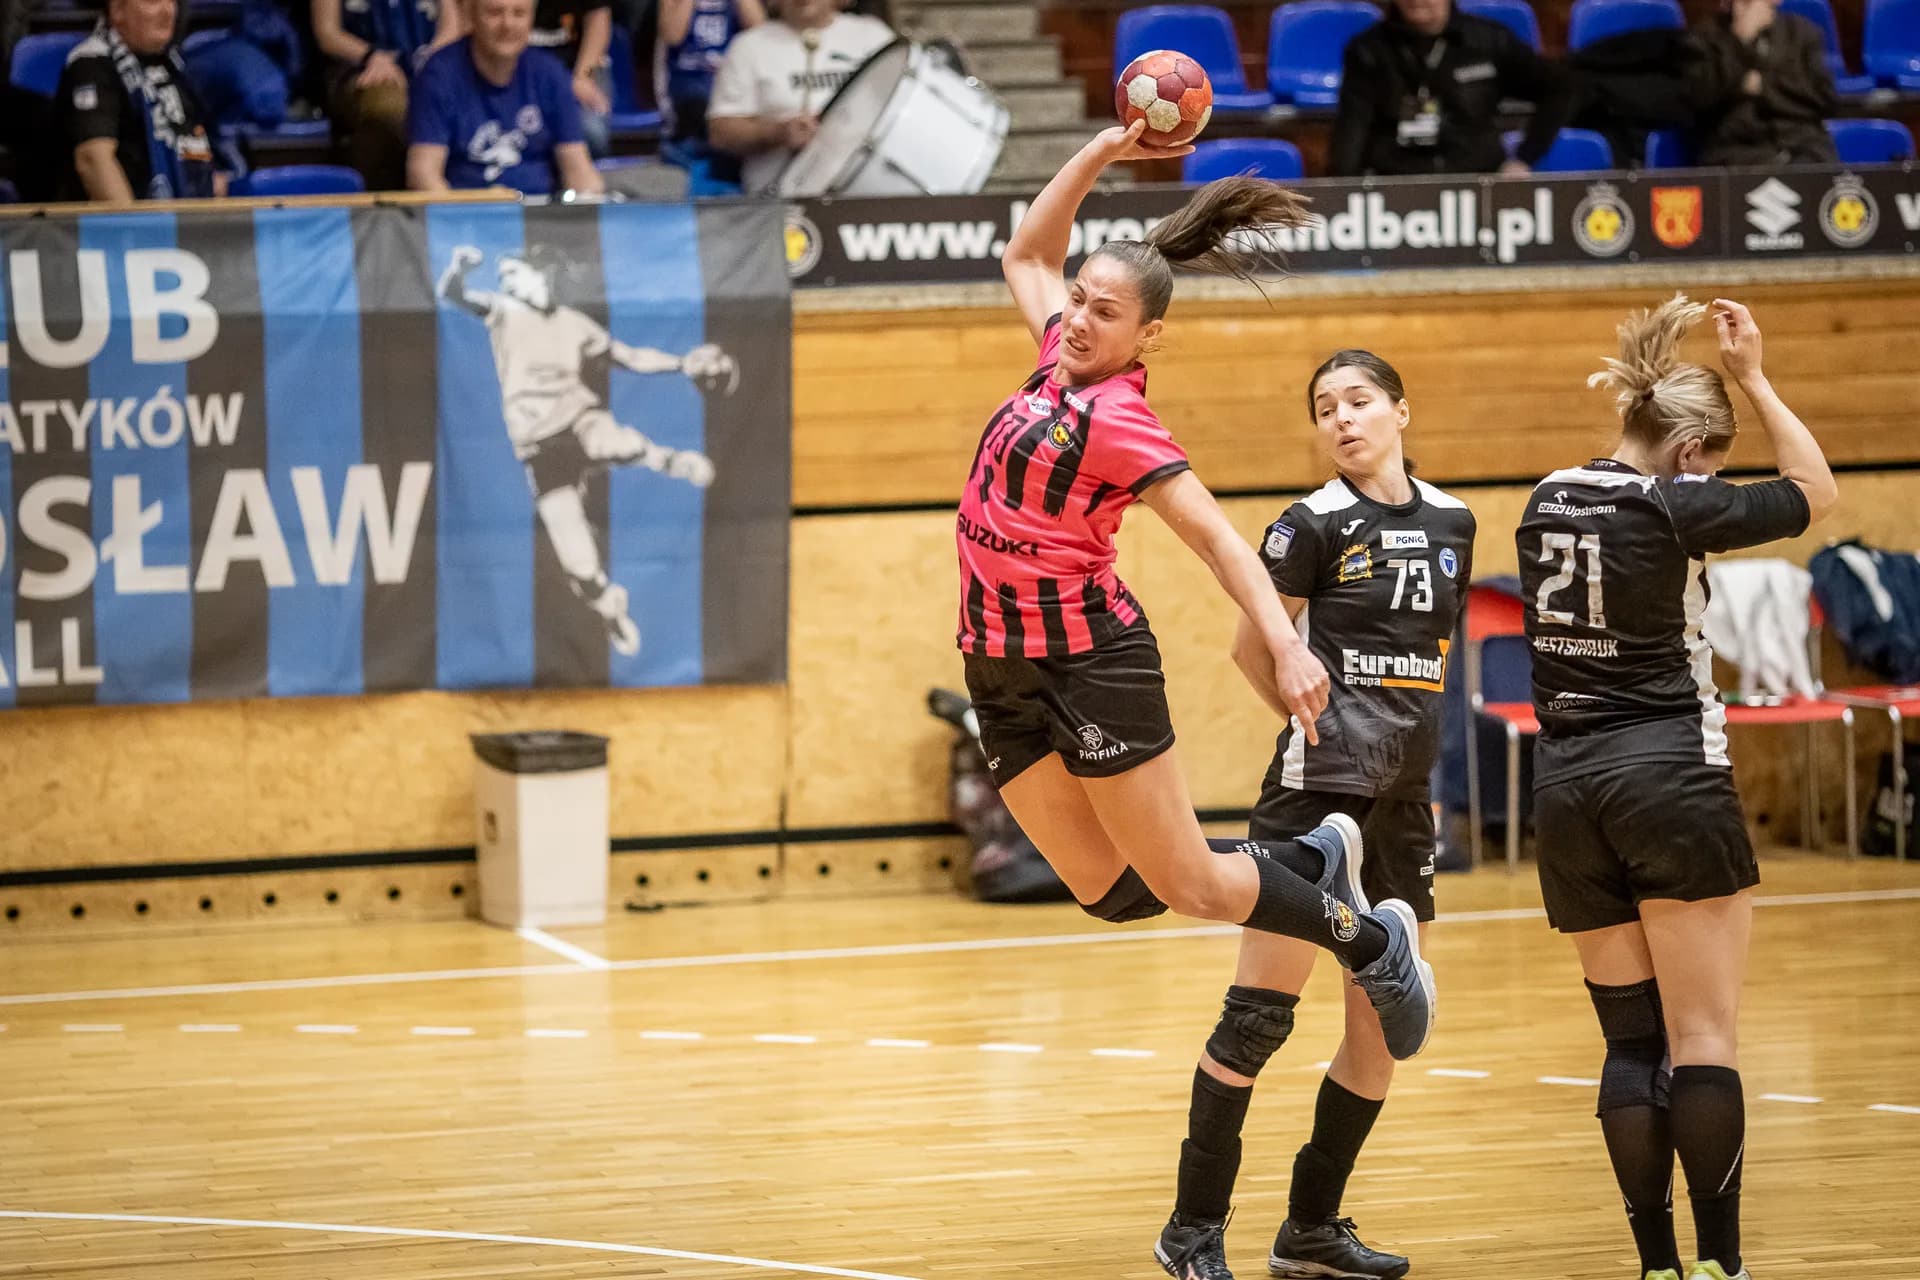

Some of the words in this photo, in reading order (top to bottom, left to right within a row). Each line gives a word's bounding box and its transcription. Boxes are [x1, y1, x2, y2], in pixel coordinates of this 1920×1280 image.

[0, 248, 219, 368] UB
[0, 461, 434, 600] SŁAW
[958, 511, 1039, 556] SUZUKI
[1565, 505, 1617, 518] Upstream
[1386, 559, 1433, 612] 73
[1536, 533, 1607, 628] 21
[0, 617, 105, 688] LL
[1342, 648, 1442, 681] Eurobud
[1344, 673, 1381, 688] Grupa
